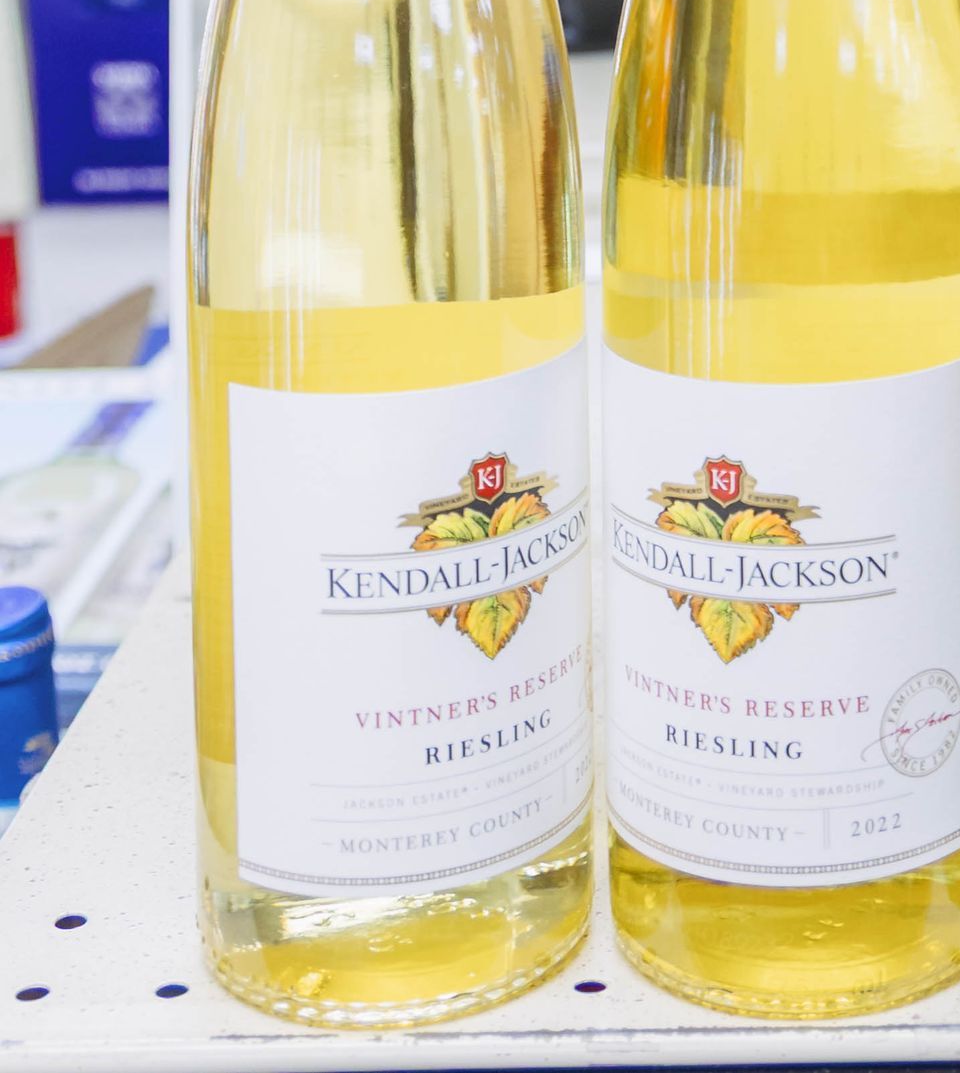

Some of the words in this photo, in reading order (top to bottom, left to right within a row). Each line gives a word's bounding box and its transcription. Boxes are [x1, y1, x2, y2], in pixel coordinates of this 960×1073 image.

[356, 692, 498, 729] VINTNER'S
[509, 644, 582, 703] RESERVE
[625, 664, 731, 714] VINTNER'S
[746, 695, 870, 718] RESERVE
[425, 708, 551, 765] RIESLING
[665, 724, 802, 759] RIESLING
[340, 827, 460, 854] MONTEREY
[469, 799, 544, 837] COUNTY
[618, 780, 695, 828] MONTEREY
[702, 818, 790, 841] COUNTY
[851, 812, 902, 837] 2022
